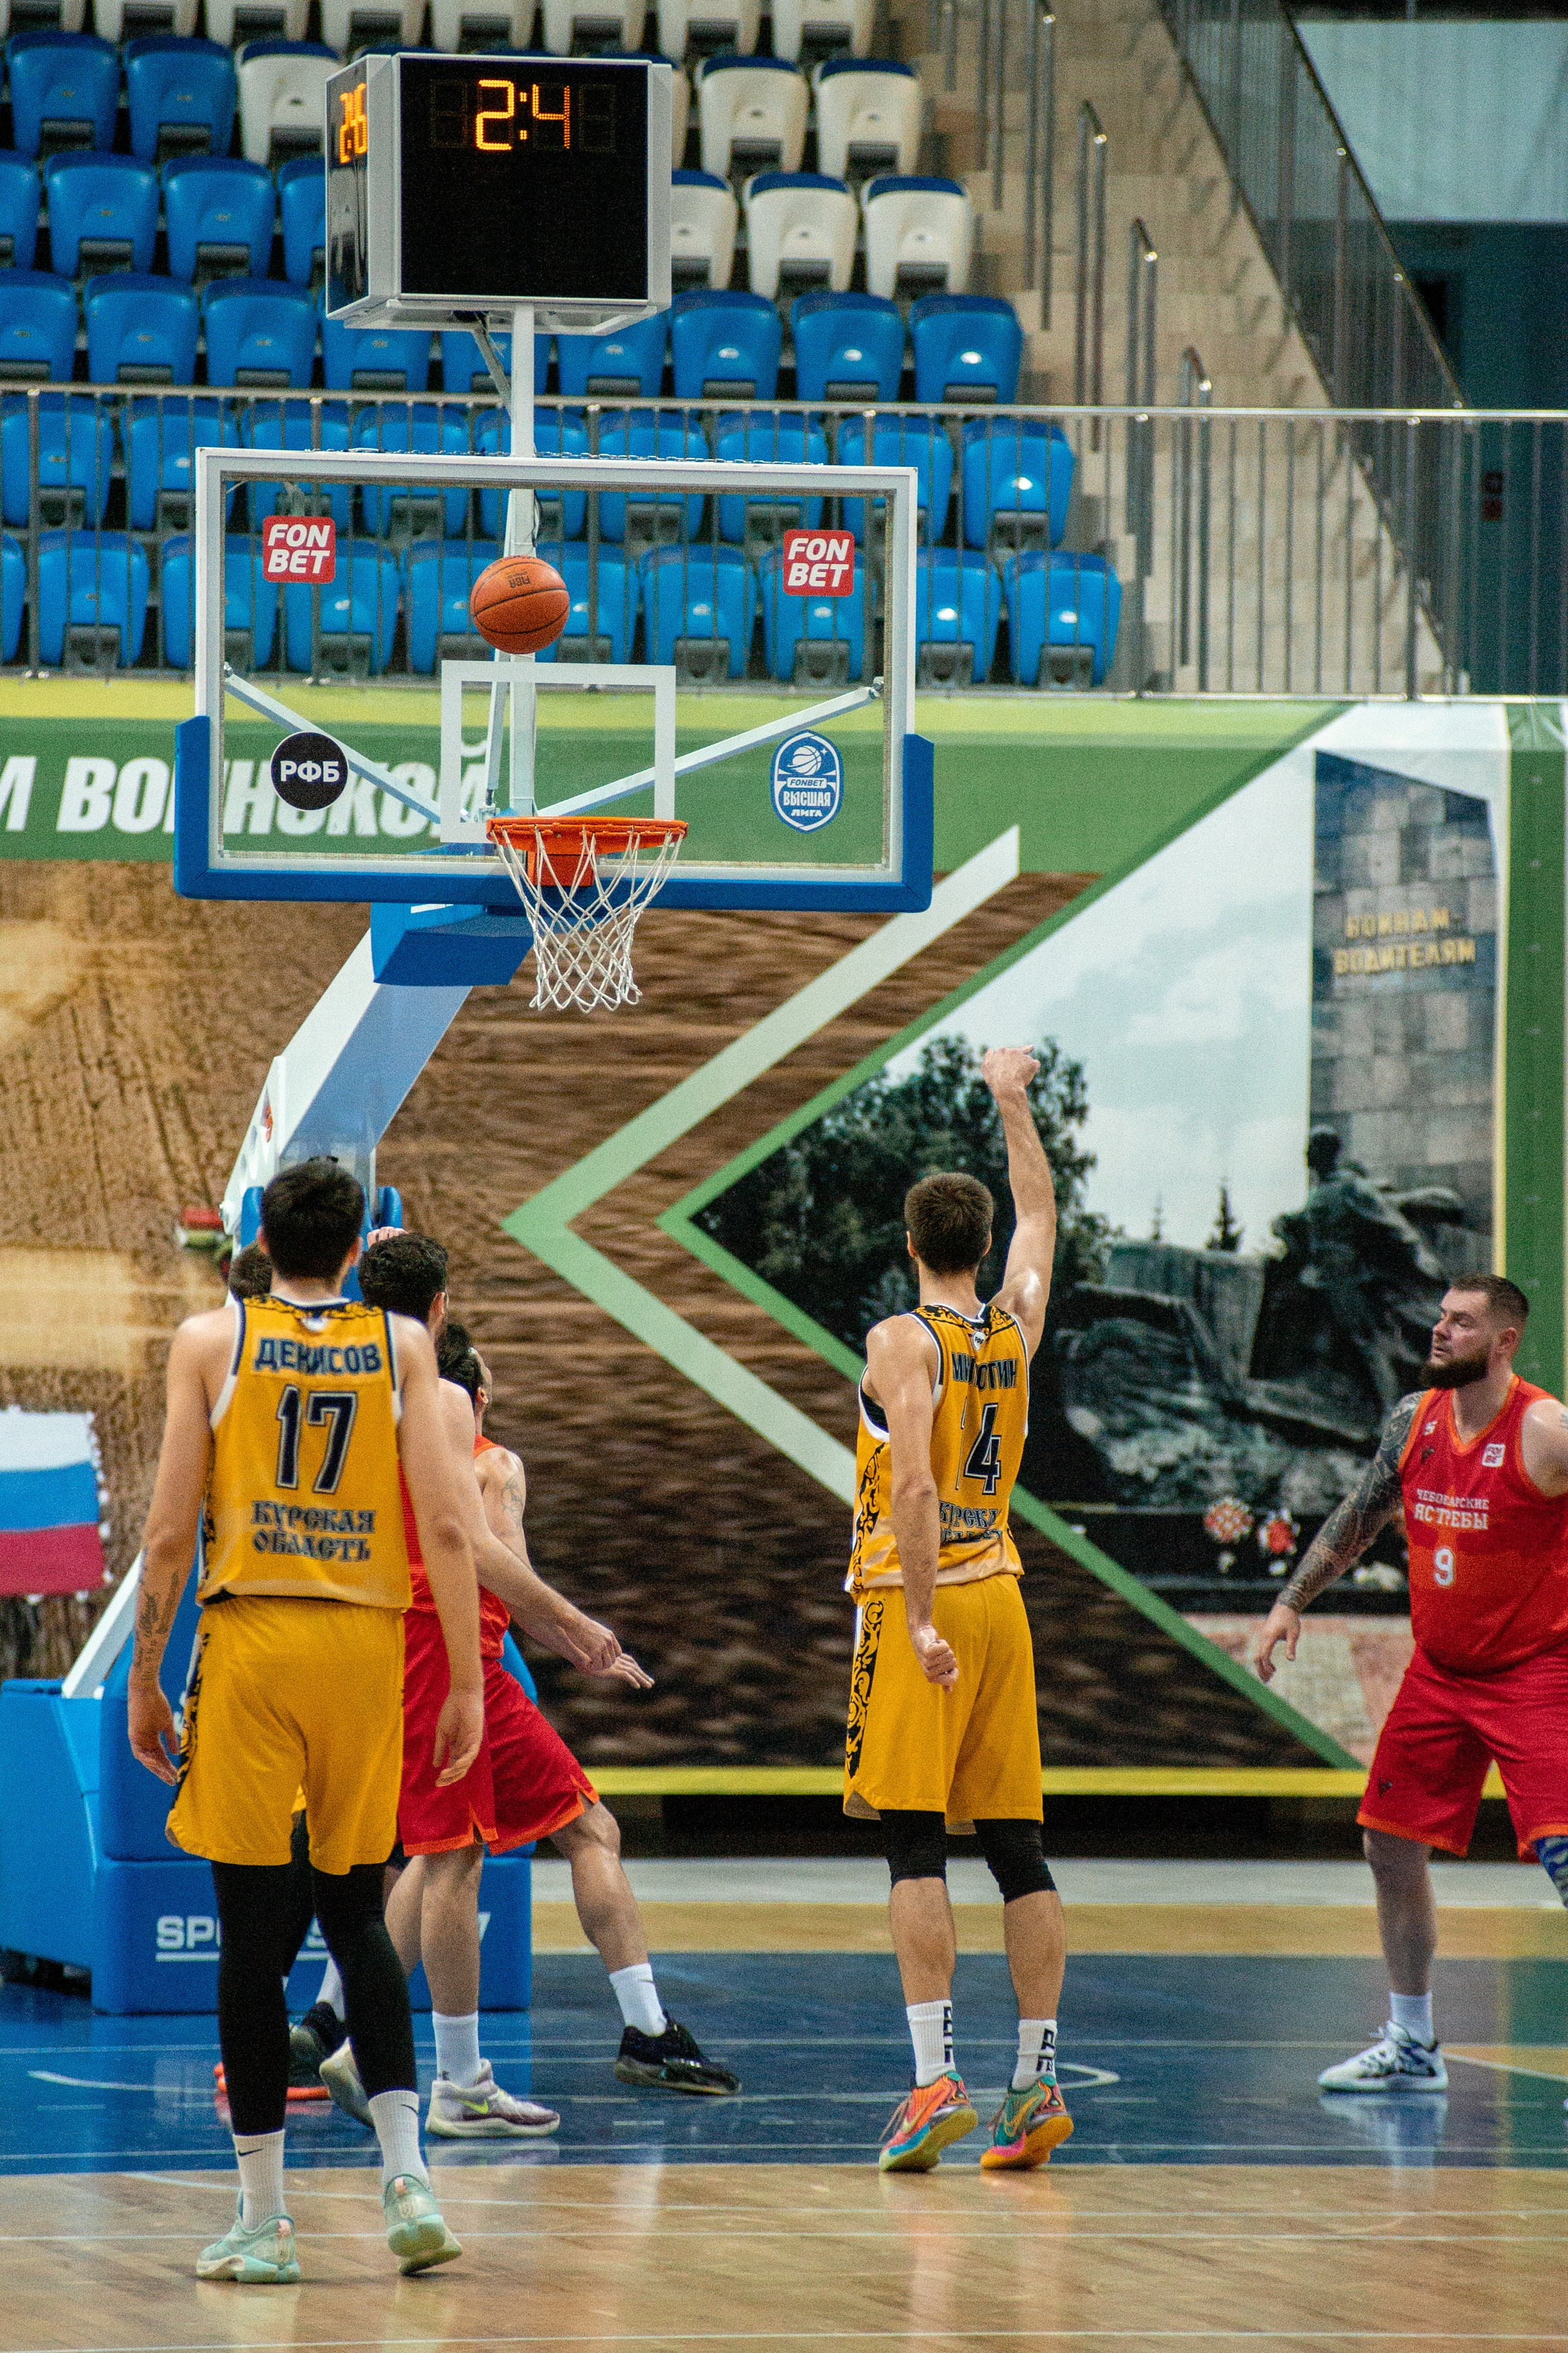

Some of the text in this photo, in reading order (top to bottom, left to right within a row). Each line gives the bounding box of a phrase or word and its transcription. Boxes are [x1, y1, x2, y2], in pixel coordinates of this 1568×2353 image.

[475, 79, 571, 151] 2:4
[267, 524, 330, 547] FON
[267, 549, 330, 574] BET
[788, 538, 850, 561] FON
[788, 563, 850, 587] BET
[280, 760, 340, 783] РФБ
[783, 791, 831, 807] ВЫСШАЯ
[791, 809, 823, 817] ЛИГА
[253, 1337, 382, 1374] ДЕНИСОВ
[276, 1384, 358, 1494] 17
[956, 1396, 1002, 1496] 4
[251, 1500, 376, 1533] КУРСКАЯ
[1414, 1503, 1489, 1530] ЯСТРЕБЫ
[252, 1529, 371, 1562] ОБЛАСТЬ
[1434, 1548, 1454, 1587] 9
